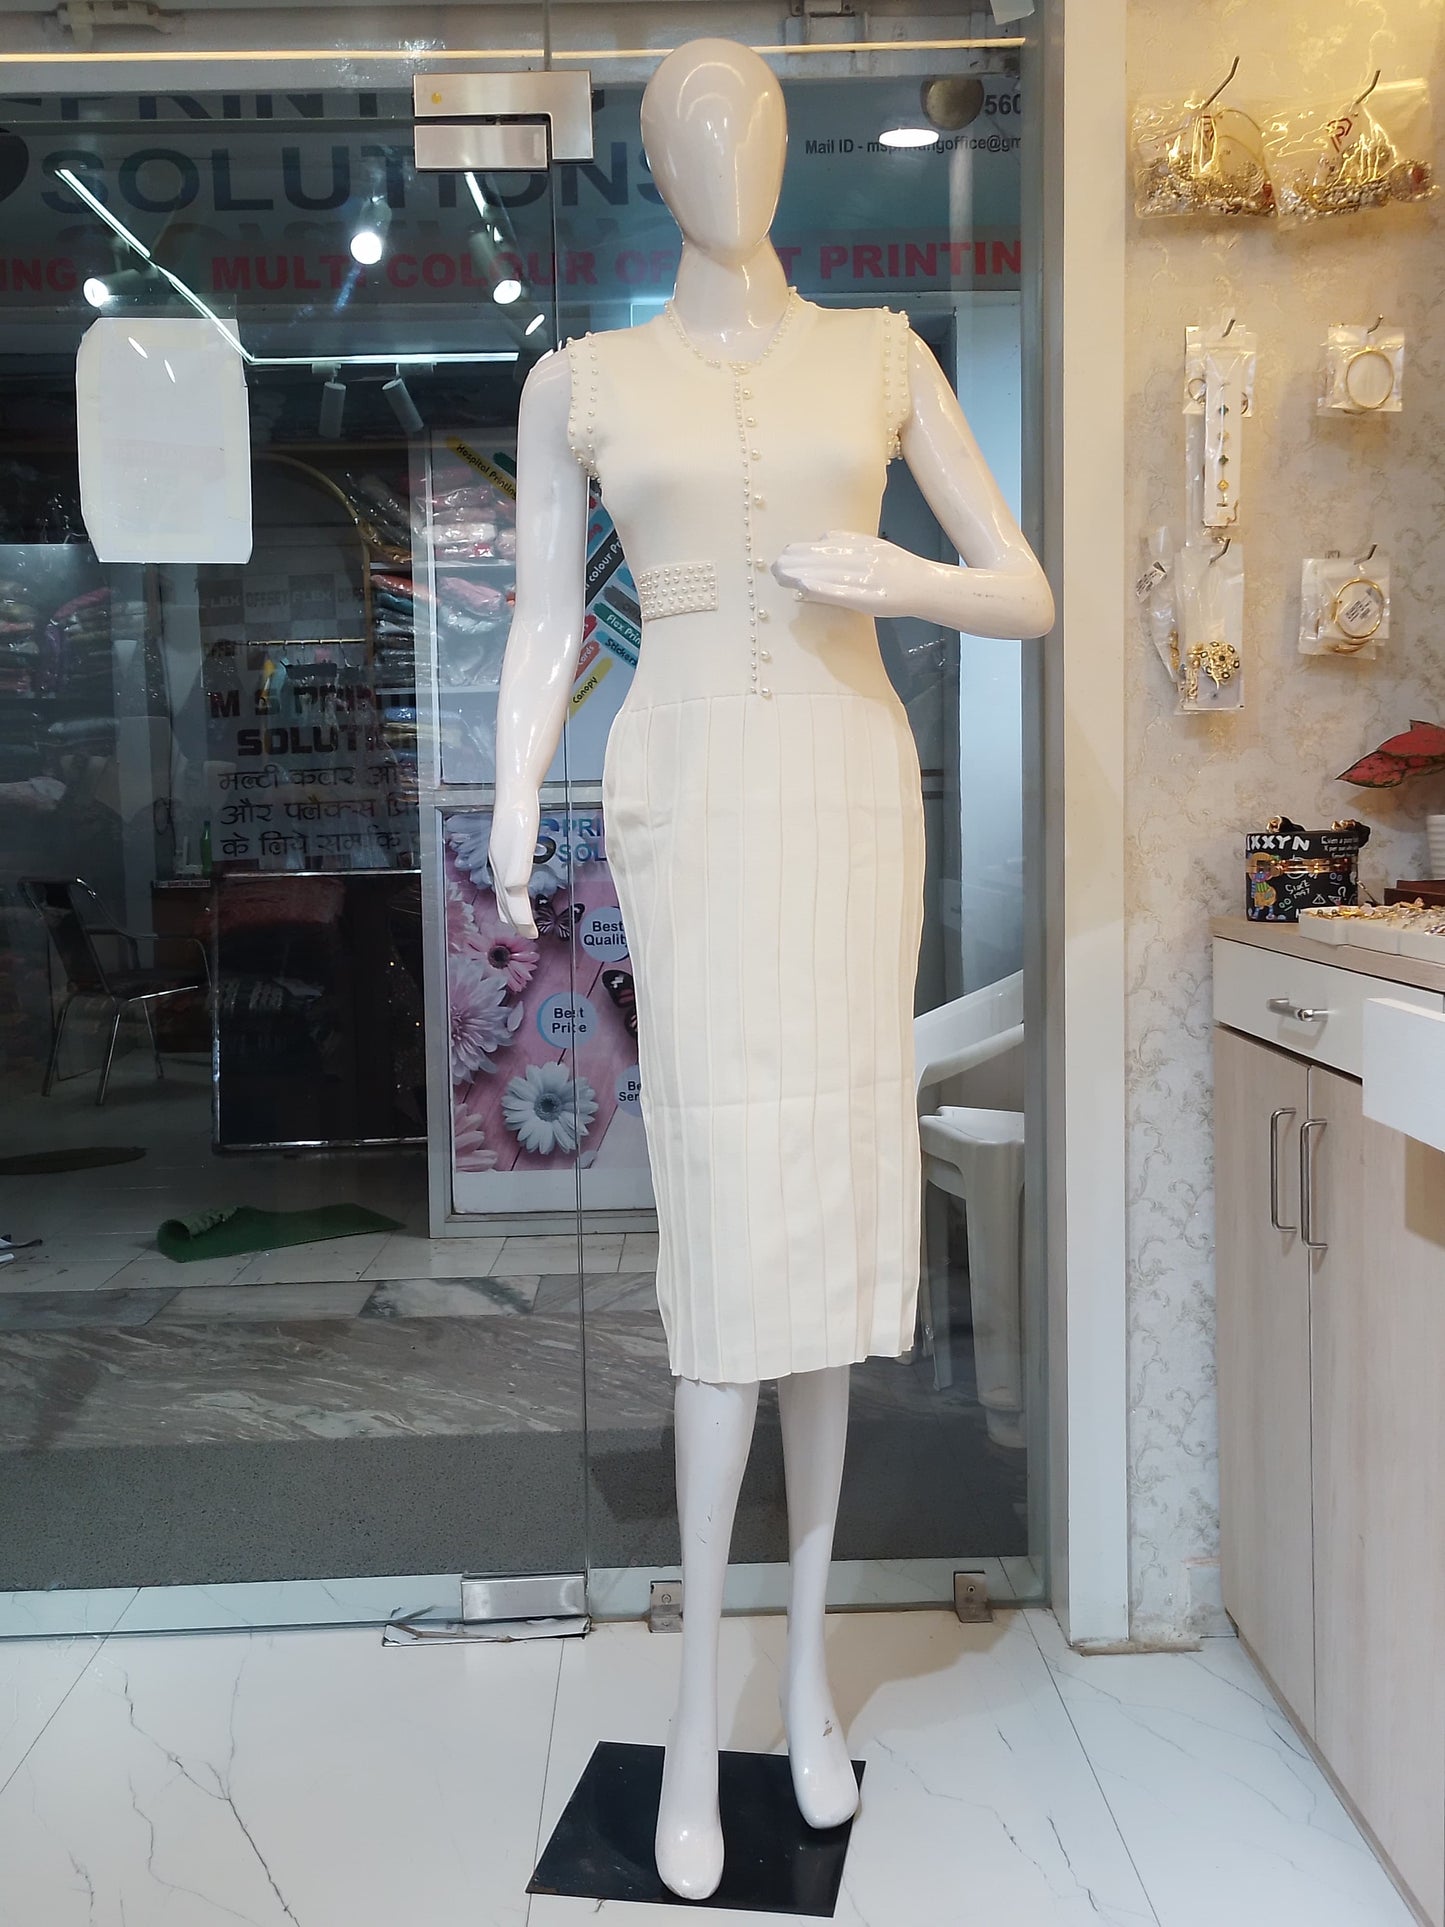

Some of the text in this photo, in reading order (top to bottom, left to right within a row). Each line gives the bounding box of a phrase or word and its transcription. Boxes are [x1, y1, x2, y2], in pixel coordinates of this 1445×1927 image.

[805, 139, 835, 154] Mail
[839, 138, 854, 153] ID
[387, 251, 598, 288] COLOUR
[820, 240, 1021, 279] PRINTIN
[456, 443, 490, 473] Hospital
[588, 552, 613, 582] colour
[572, 676, 598, 703] Canopy
[220, 798, 274, 825] और
[220, 831, 250, 857] के
[592, 920, 624, 932] Best
[583, 934, 627, 947] Qualit
